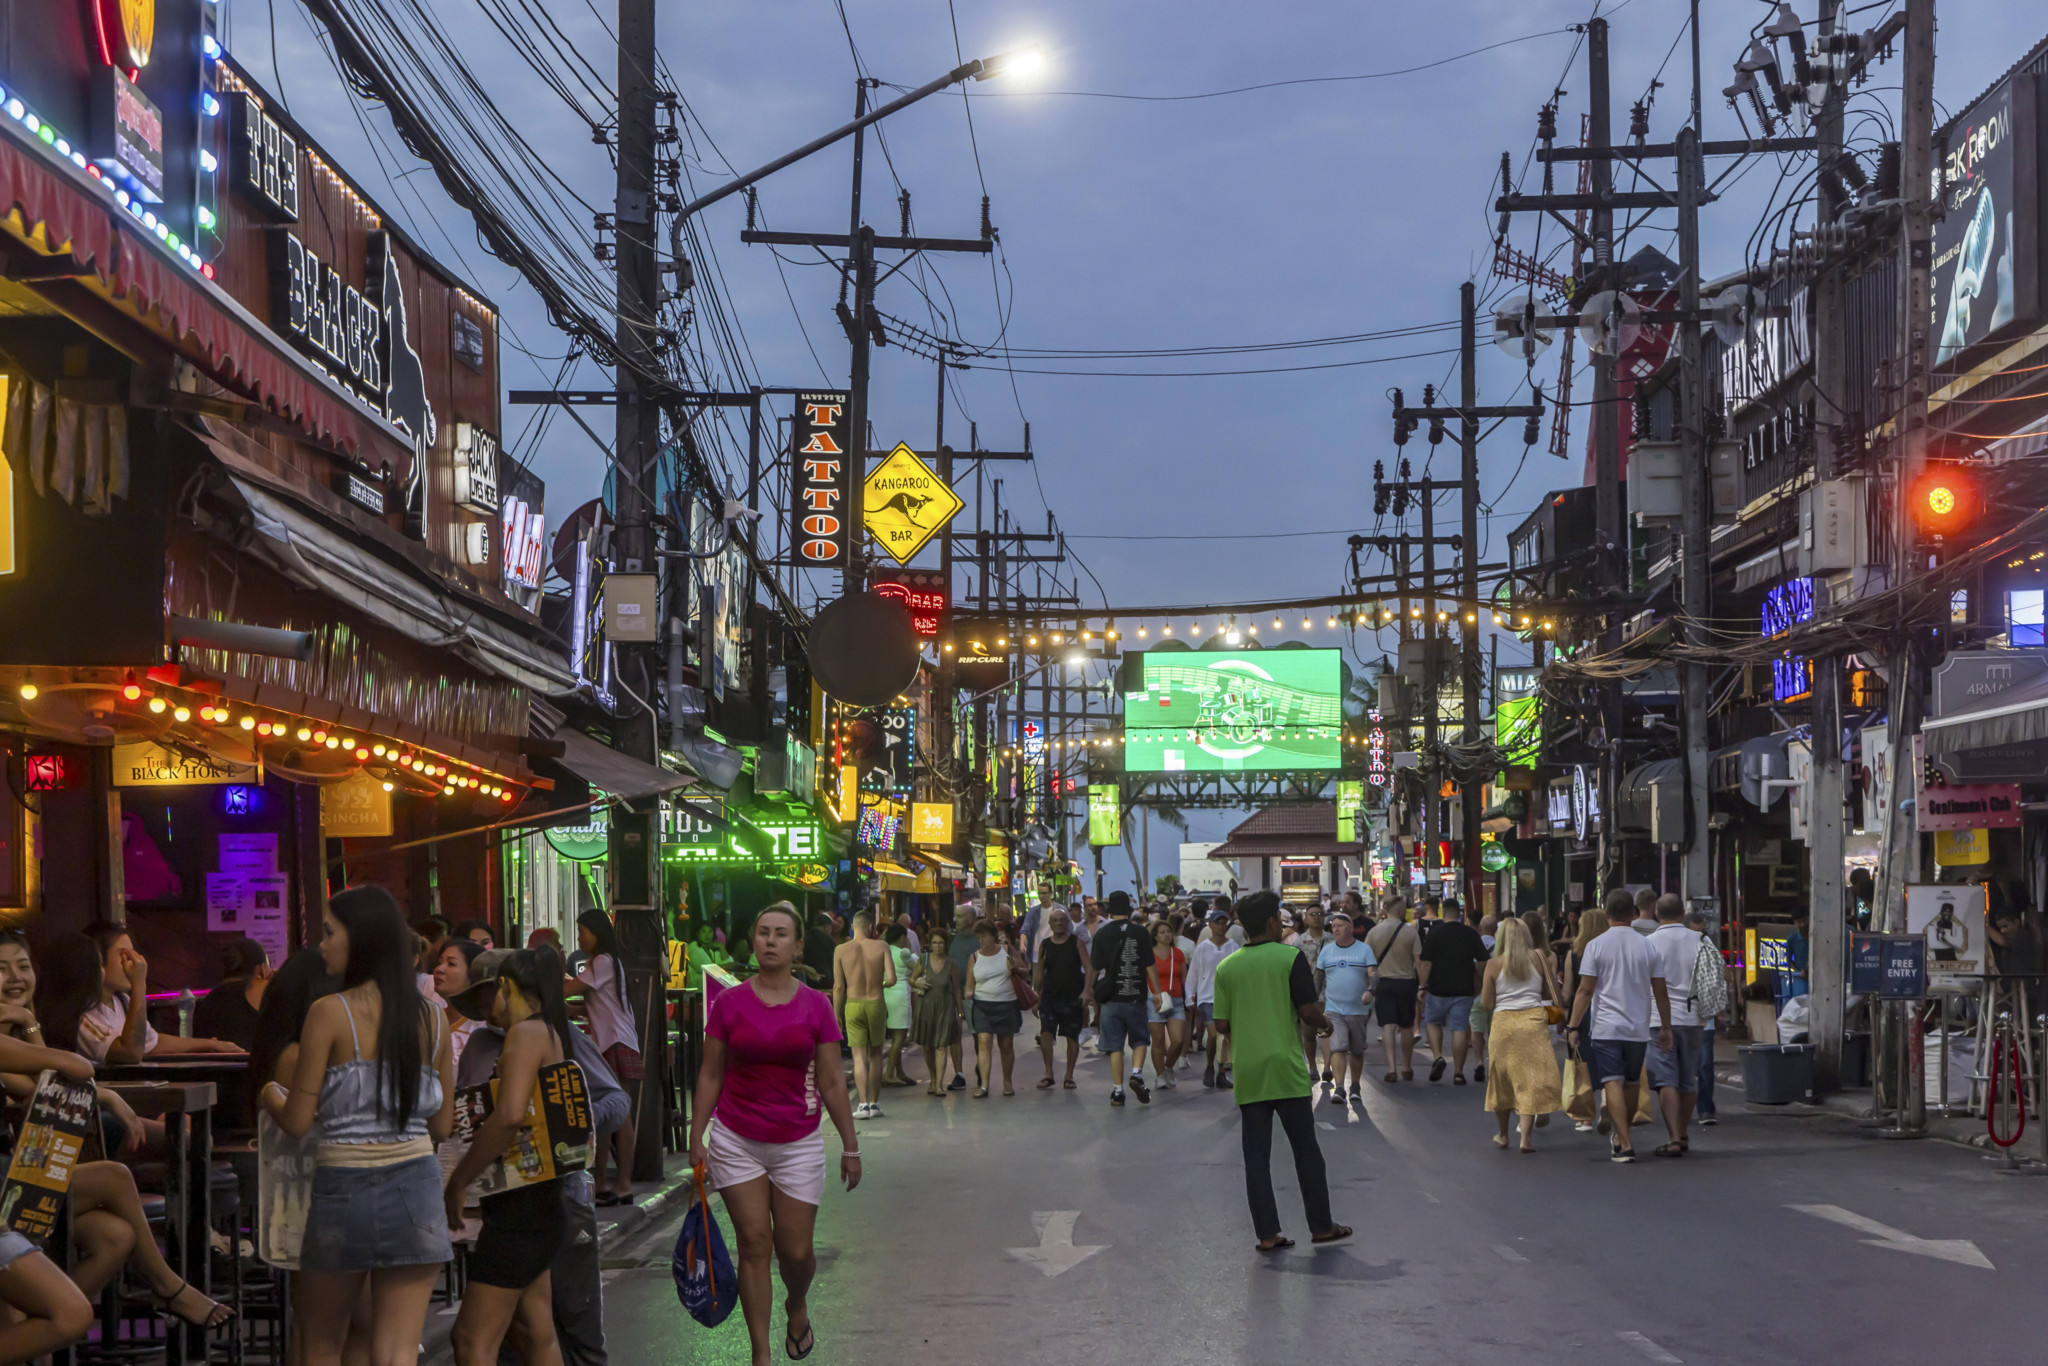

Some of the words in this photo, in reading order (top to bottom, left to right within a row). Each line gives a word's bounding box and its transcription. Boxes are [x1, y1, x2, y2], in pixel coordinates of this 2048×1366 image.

[246, 95, 298, 219] THE
[288, 231, 381, 392] BLACK
[469, 429, 497, 482] JACK
[800, 403, 843, 560] TATTOO
[874, 477, 930, 491] KANGAROO
[890, 529, 914, 543] BAR
[619, 605, 639, 613] CAT
[911, 594, 944, 610] BAR
[958, 656, 978, 664] RIP
[978, 656, 1005, 664] CURL
[143, 757, 165, 768] THE
[131, 767, 180, 780] BLACK
[181, 765, 236, 779] HORE
[1339, 799, 1361, 809] Chan
[1891, 959, 1914, 968] FREE
[1887, 968, 1918, 978] ENTRY
[545, 1070, 563, 1105] ALL
[569, 1073, 582, 1094] GET
[559, 1067, 577, 1127] COCKTAILS
[456, 1094, 475, 1140] HOUR
[574, 1106, 588, 1129] BUY
[37, 1195, 58, 1213] ALL
